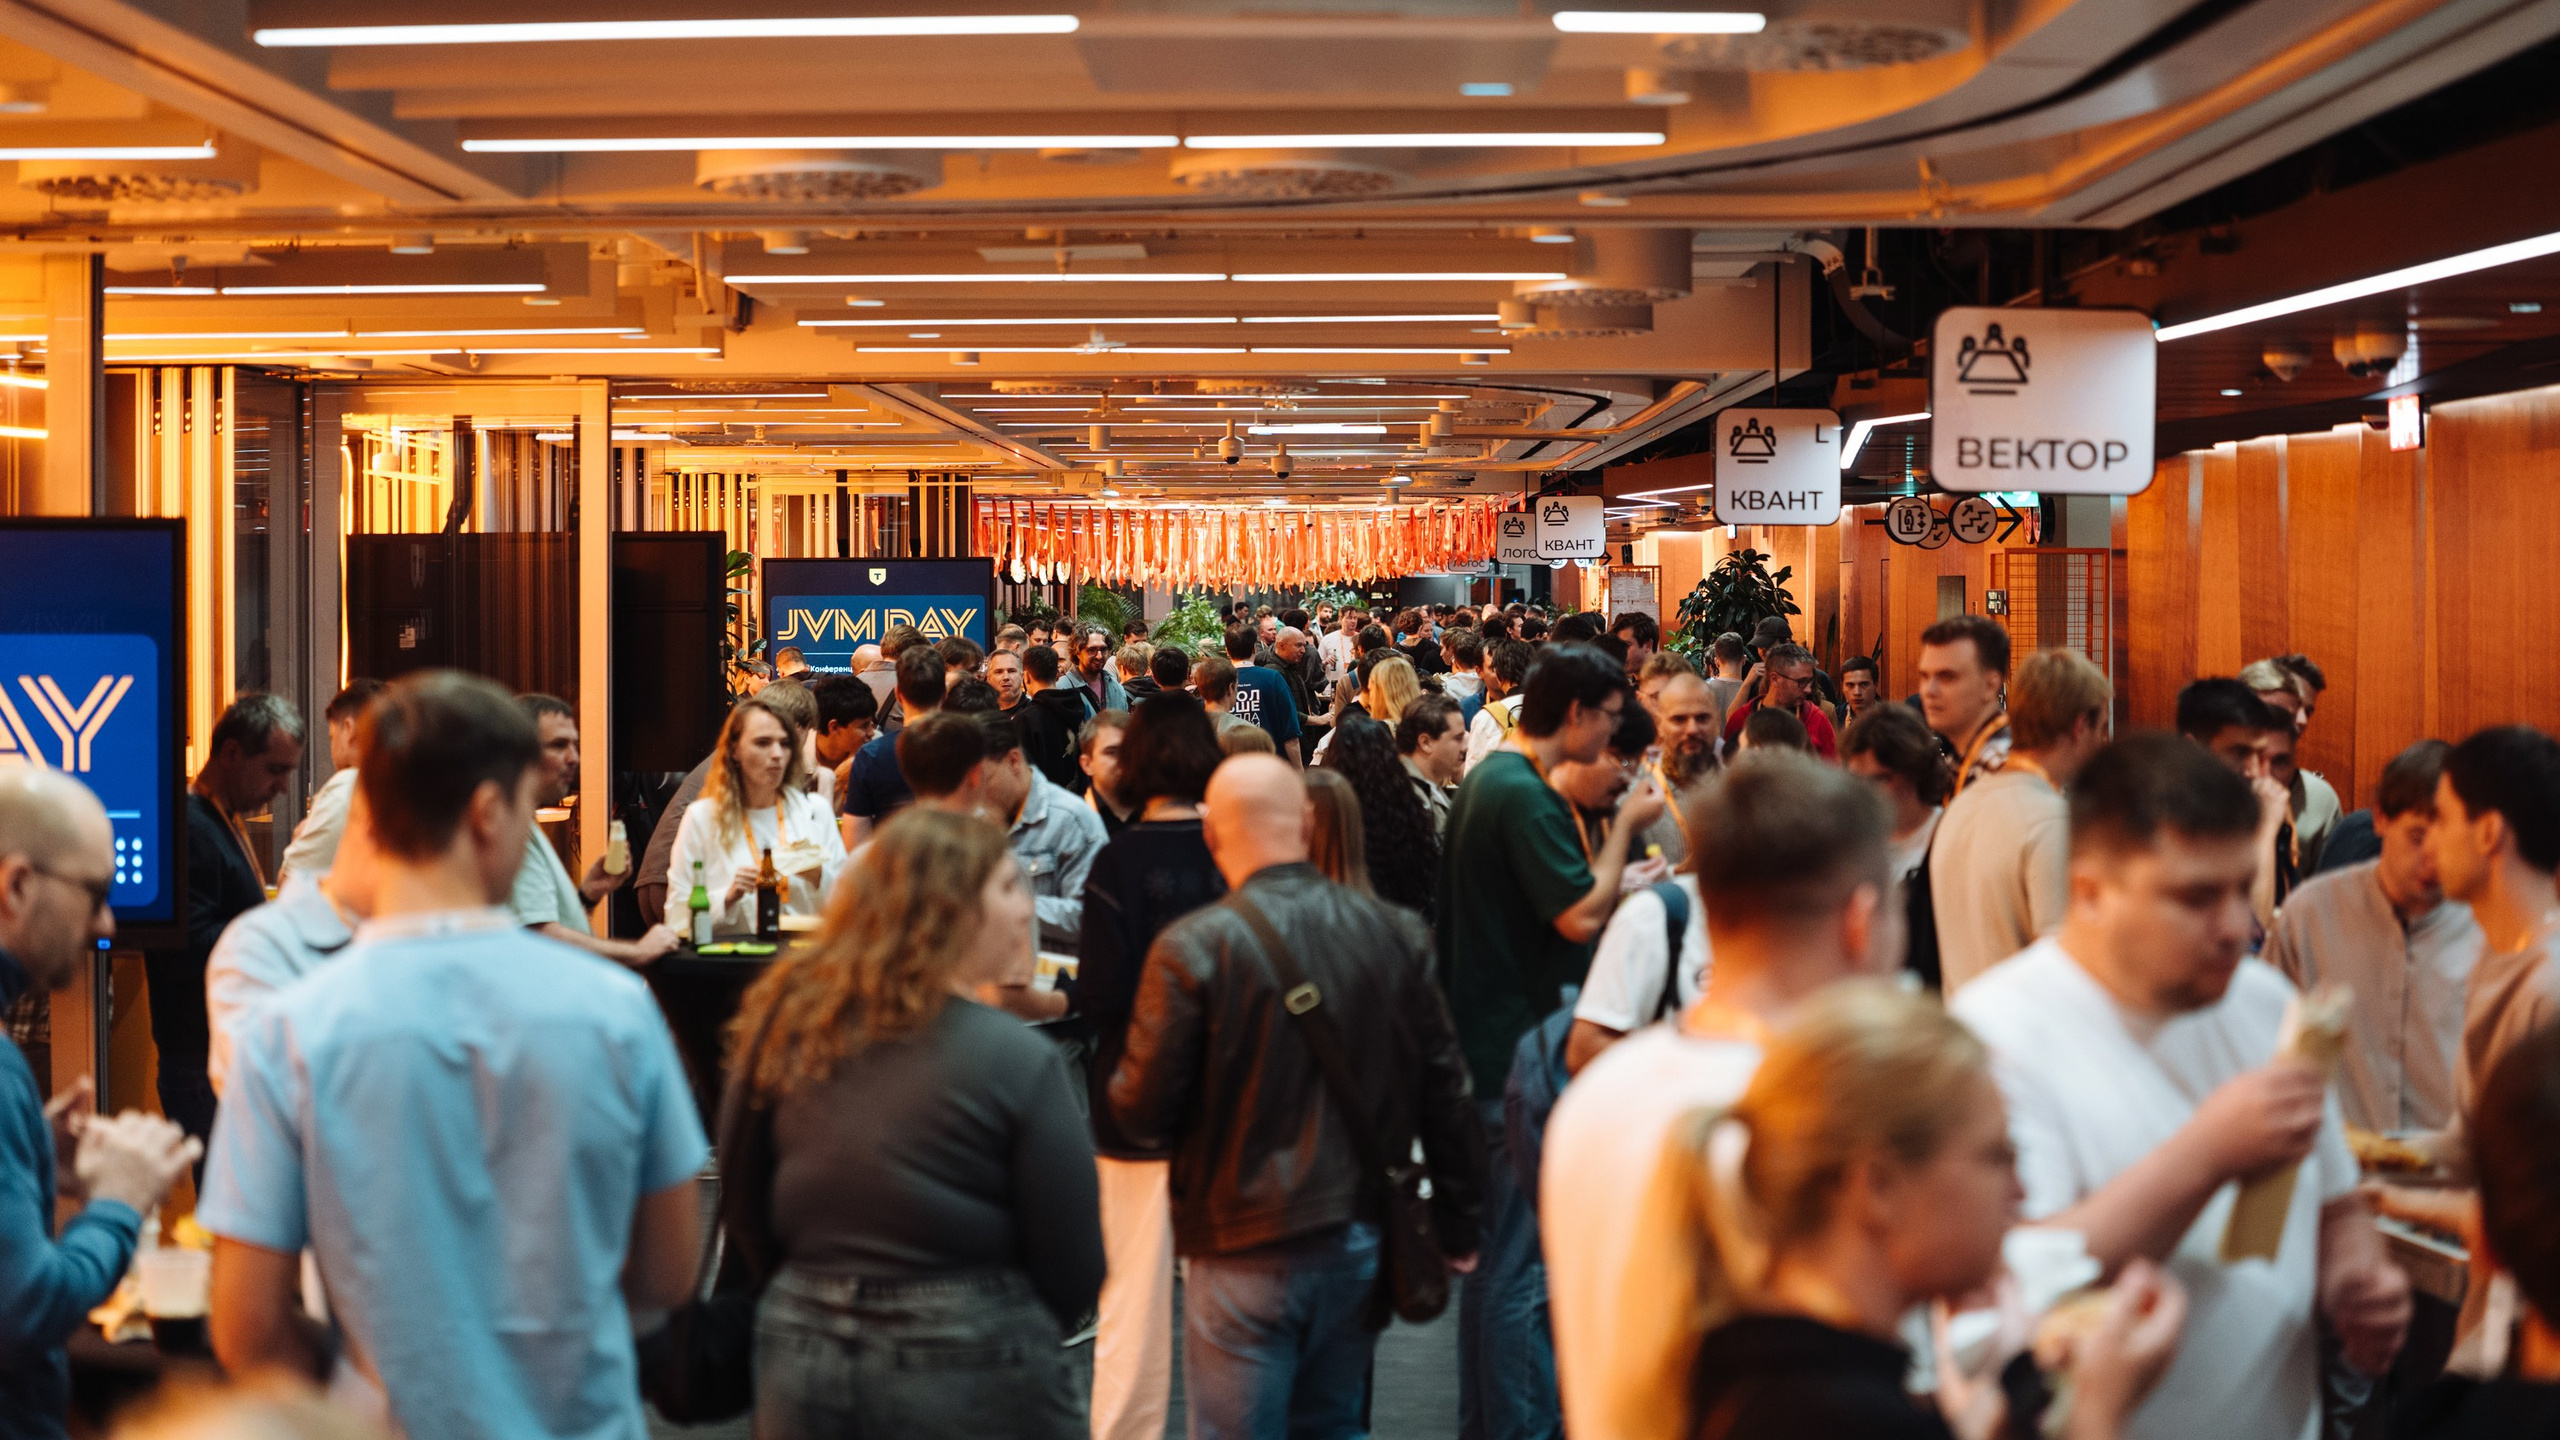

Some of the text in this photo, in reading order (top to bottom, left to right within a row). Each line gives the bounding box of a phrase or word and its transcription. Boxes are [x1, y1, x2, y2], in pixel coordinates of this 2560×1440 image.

[1957, 437, 2129, 471] ВЕКТОР
[1731, 490, 1824, 510] КВАНТ
[1544, 539, 1596, 551] КВАНТ
[777, 608, 876, 643] JVM
